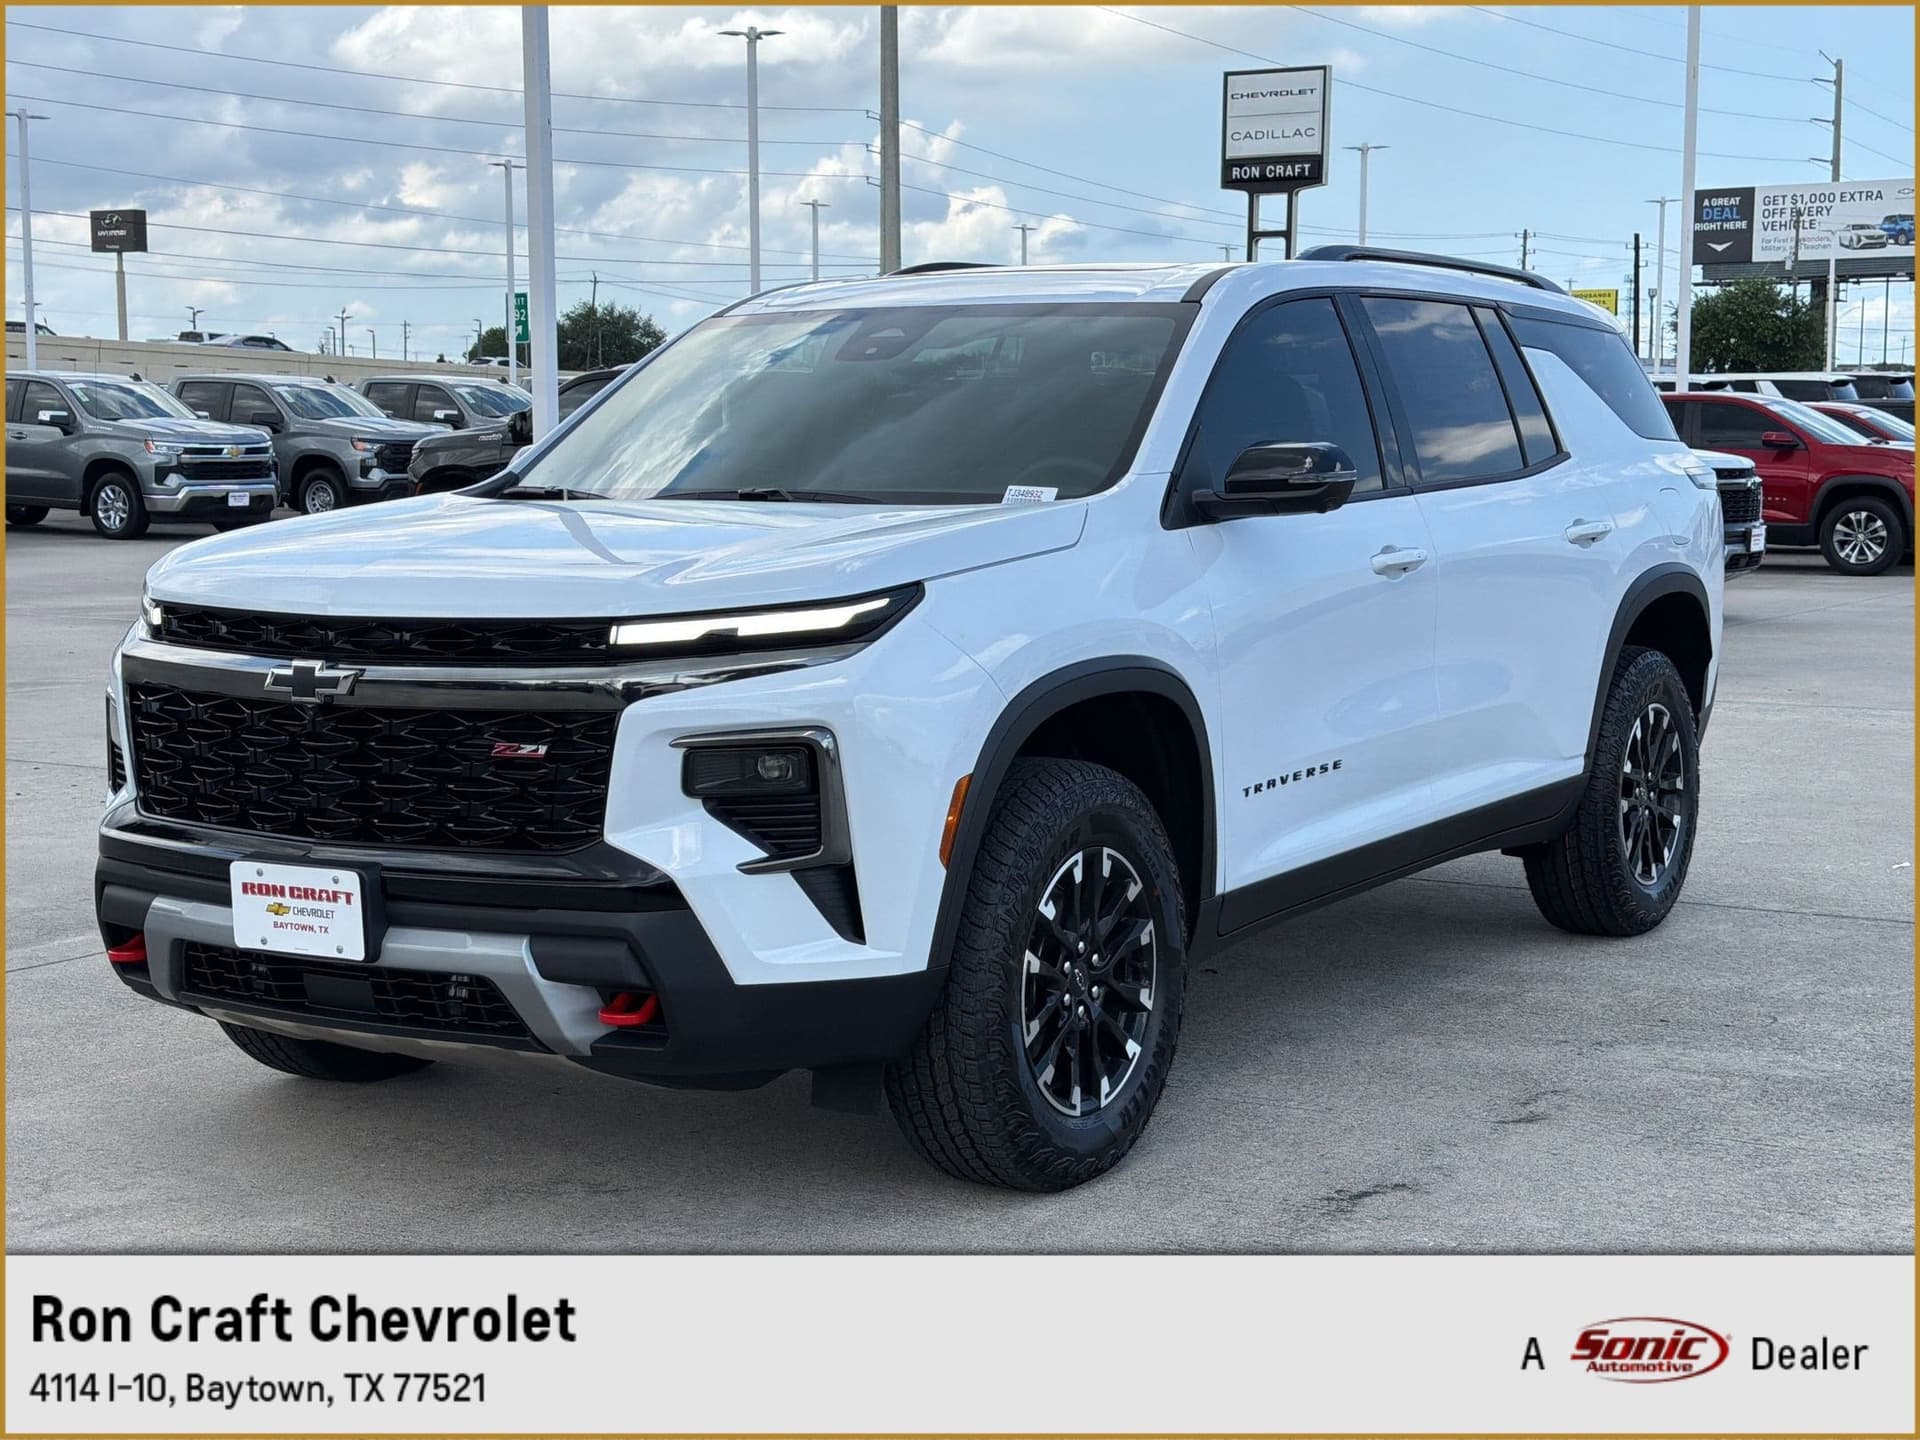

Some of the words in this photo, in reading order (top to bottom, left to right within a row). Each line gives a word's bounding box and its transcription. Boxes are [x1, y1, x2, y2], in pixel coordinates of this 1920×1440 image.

[1231, 88, 1317, 100] CHEVROLET
[1231, 127, 1316, 141] CADILLAC
[1232, 166, 1260, 179] RON
[1266, 163, 1311, 177] CRAFT
[1703, 198, 1710, 207] A
[1711, 196, 1741, 206] GREAT
[1762, 195, 1788, 207] GET
[1790, 192, 1836, 207] $1,000
[1840, 190, 1884, 202] EXTRA
[1703, 207, 1740, 220] DEAL
[1762, 208, 1787, 219] OFF
[1790, 205, 1832, 218] EVERY
[1694, 222, 1721, 231] RIGHT
[1723, 220, 1748, 230] HERE
[1242, 759, 1343, 798] TRAVERSE
[242, 881, 286, 898] RON
[289, 886, 354, 905] CRAFT
[293, 906, 335, 920] CHEVROLET
[273, 921, 317, 934] BAYTOWN,
[319, 925, 329, 934] TX
